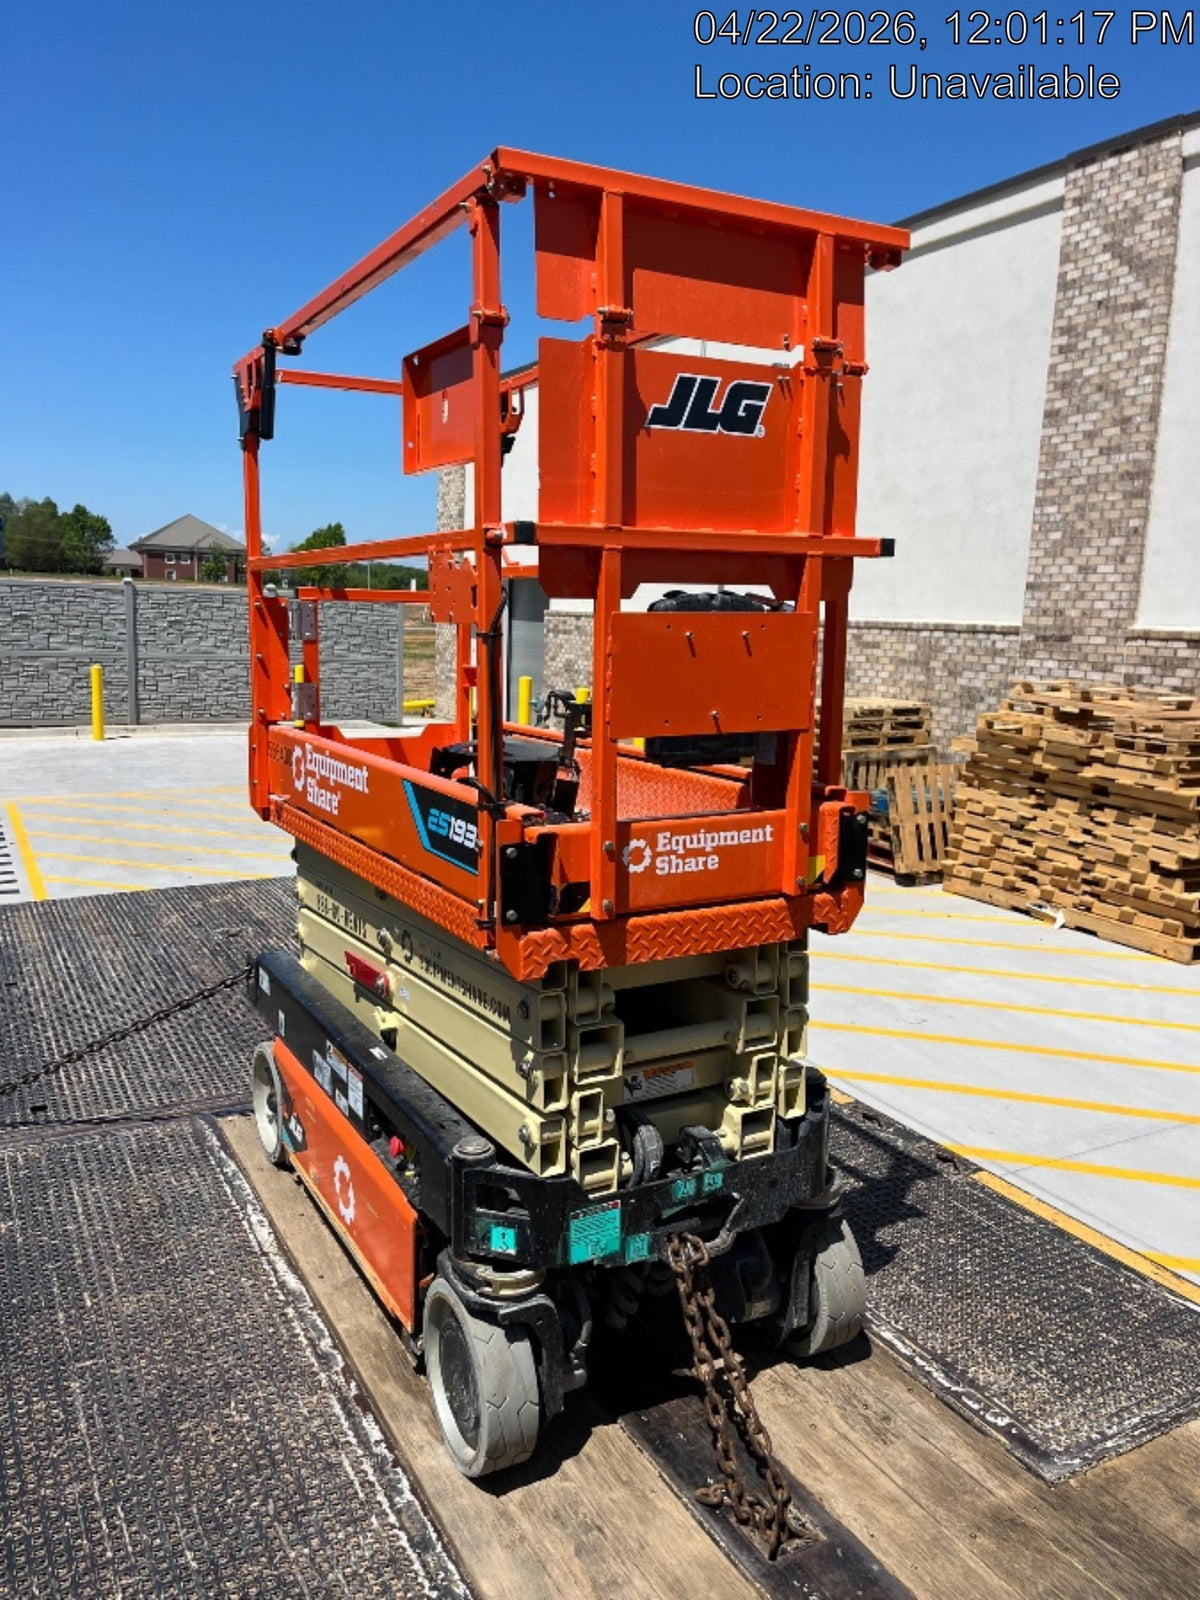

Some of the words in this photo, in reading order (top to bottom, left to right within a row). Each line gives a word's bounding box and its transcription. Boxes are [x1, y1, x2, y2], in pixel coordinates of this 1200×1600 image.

[644, 372, 774, 437] JLG
[305, 743, 369, 793] Equipment
[306, 776, 340, 815] Share
[428, 808, 479, 851] ES193
[655, 824, 774, 854] Equipment
[655, 854, 720, 875] Share
